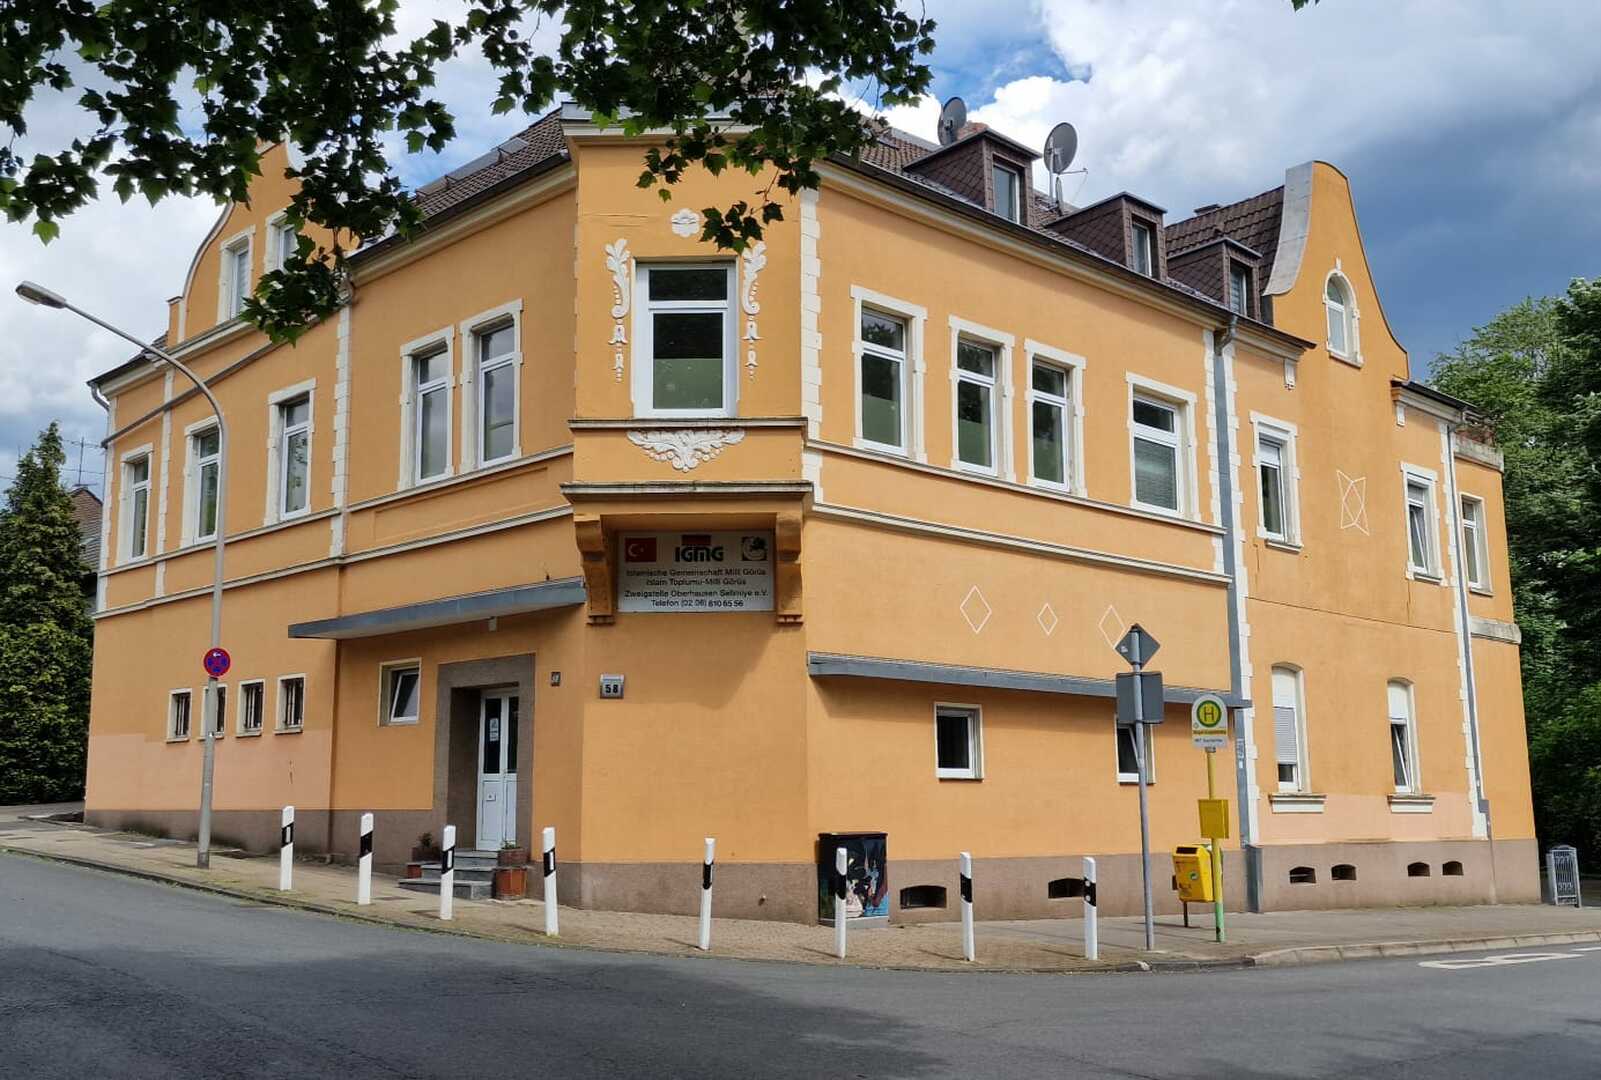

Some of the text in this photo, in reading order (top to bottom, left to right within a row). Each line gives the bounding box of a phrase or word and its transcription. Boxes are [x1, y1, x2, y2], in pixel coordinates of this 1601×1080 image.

[675, 547, 724, 562] IGMG
[670, 568, 723, 577] Gemeinschaft
[624, 590, 668, 599] Zweigstelle
[671, 589, 718, 598] Oberhausen
[651, 599, 679, 607] Telefon
[605, 684, 618, 693] 58
[1204, 706, 1214, 721] H
